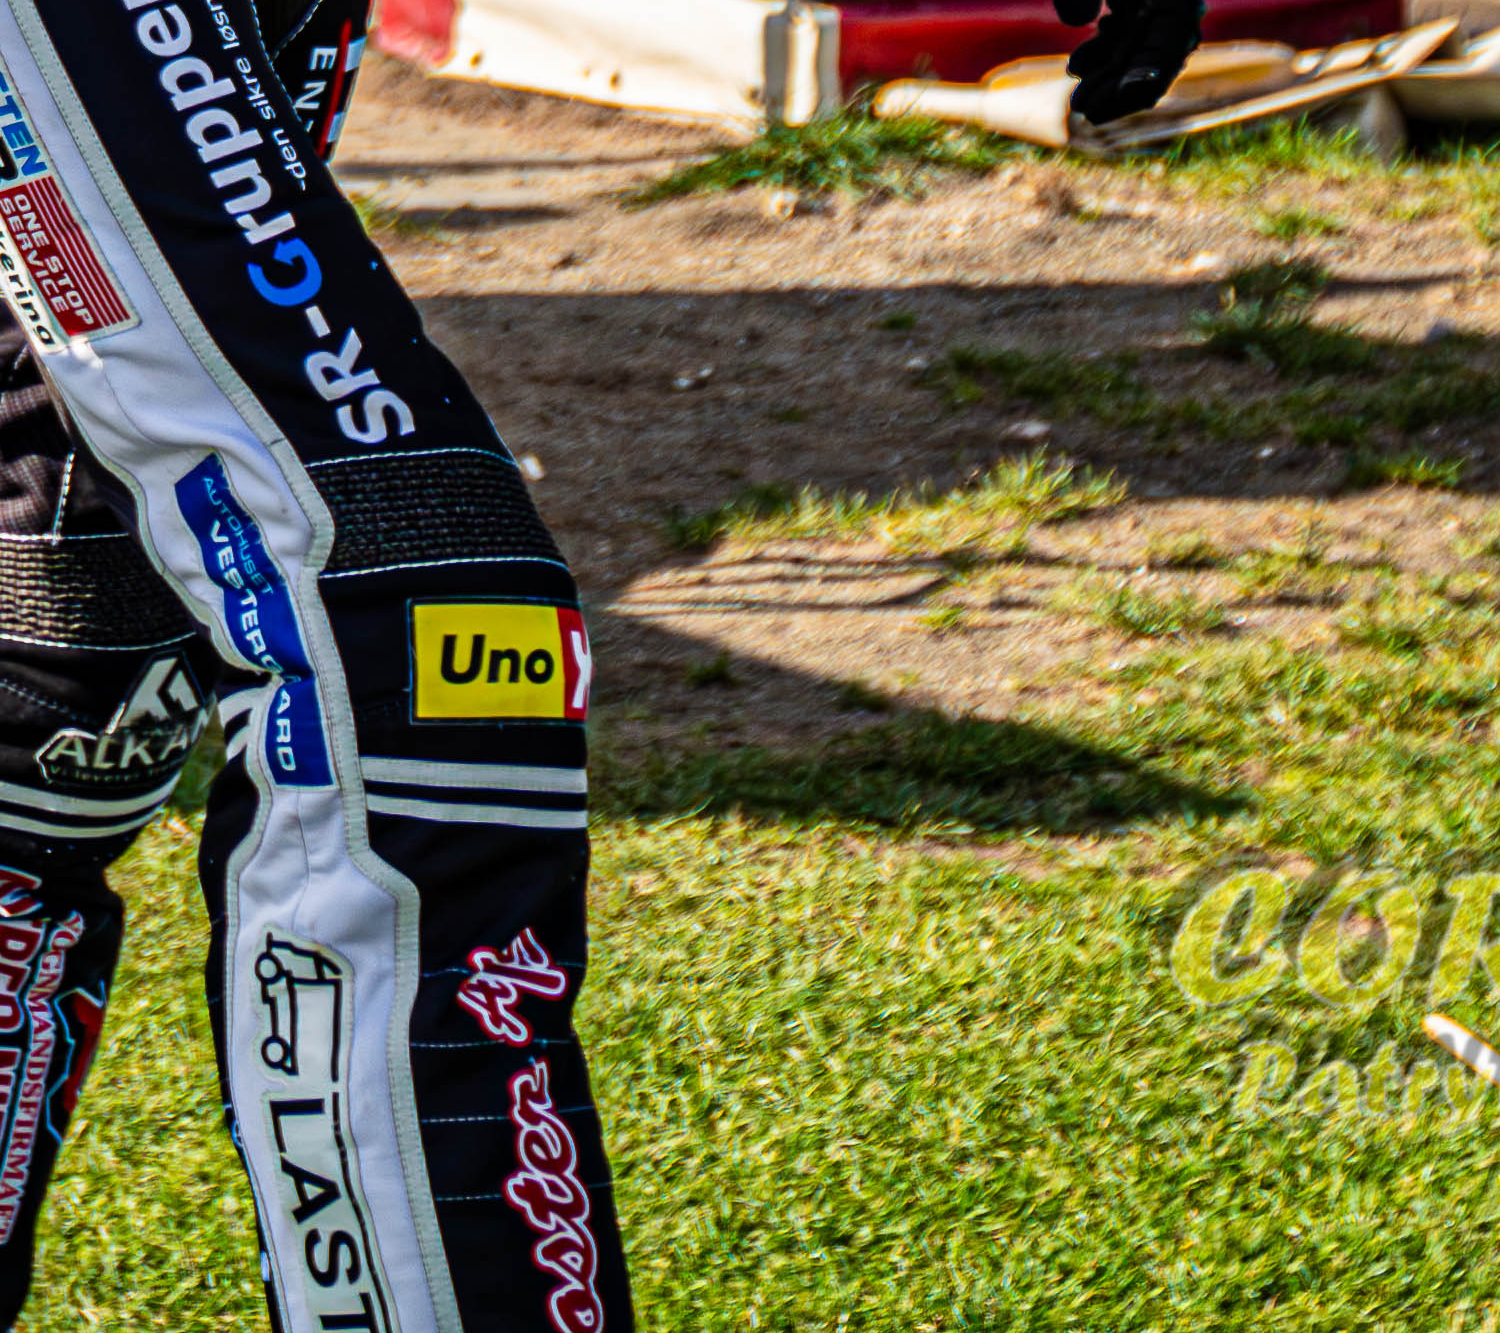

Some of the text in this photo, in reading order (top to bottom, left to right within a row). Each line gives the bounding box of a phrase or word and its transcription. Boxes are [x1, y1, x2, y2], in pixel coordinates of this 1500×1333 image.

[234, 55, 276, 121] sikre
[0, 197, 71, 315] SERVICE
[13, 193, 96, 326] ONE STOP
[203, 476, 274, 596] AUTOHUSET
[440, 633, 555, 685] Uno
